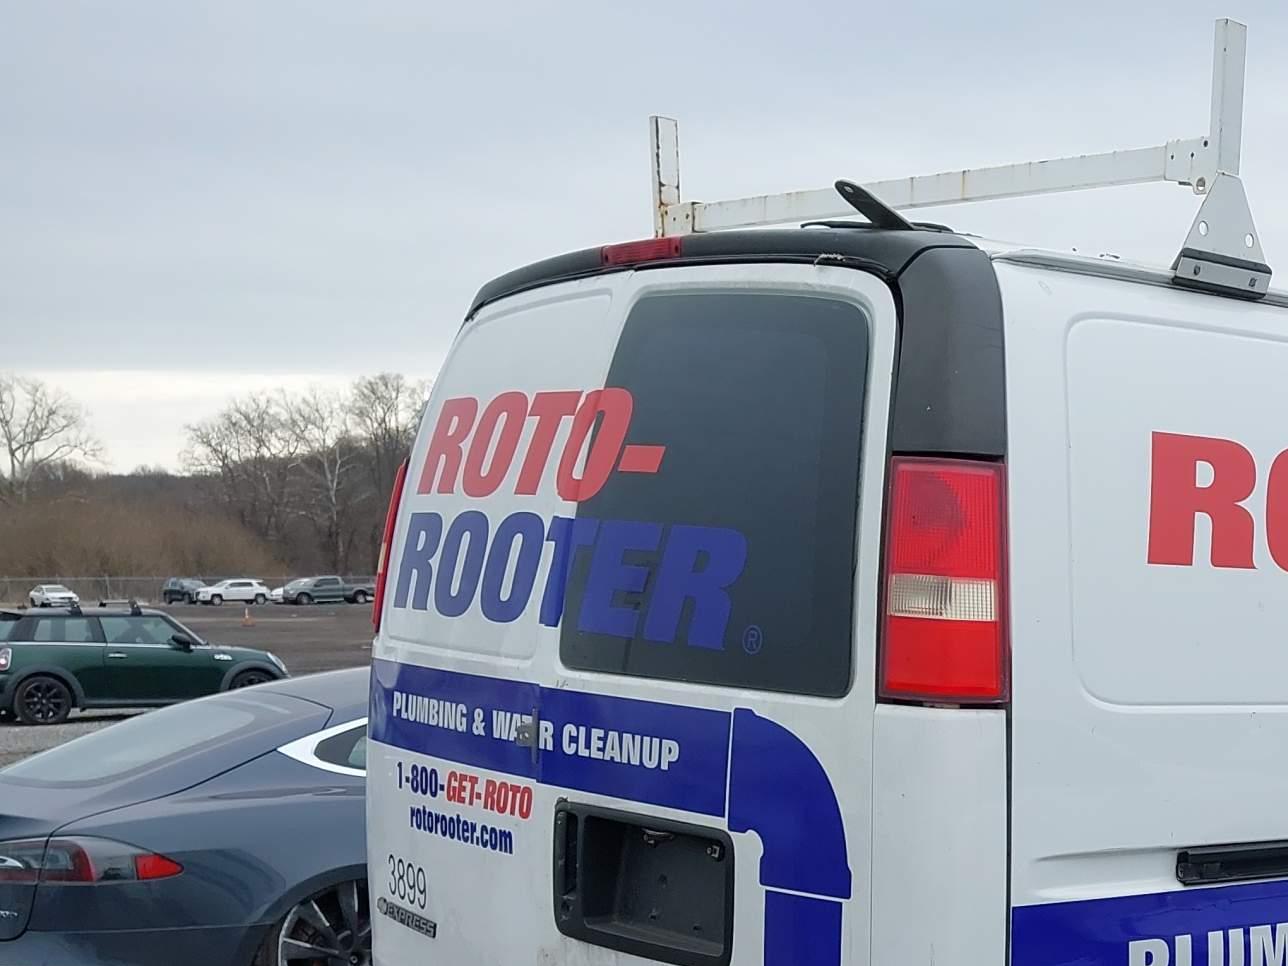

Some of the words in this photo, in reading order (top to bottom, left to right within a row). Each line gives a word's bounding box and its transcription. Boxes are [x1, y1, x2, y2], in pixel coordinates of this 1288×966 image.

[416, 387, 666, 502] ROTO-
[393, 510, 748, 650] ROOTER
[392, 690, 467, 732] PLUMBING
[472, 708, 485, 736] &
[492, 709, 554, 751] WAR
[562, 723, 680, 771] CLEANUP
[397, 761, 533, 819] 1-800-GET-ROTO
[410, 805, 513, 855] rotorooter.com
[388, 854, 427, 910] 3899
[387, 903, 435, 938] EXPRESS
